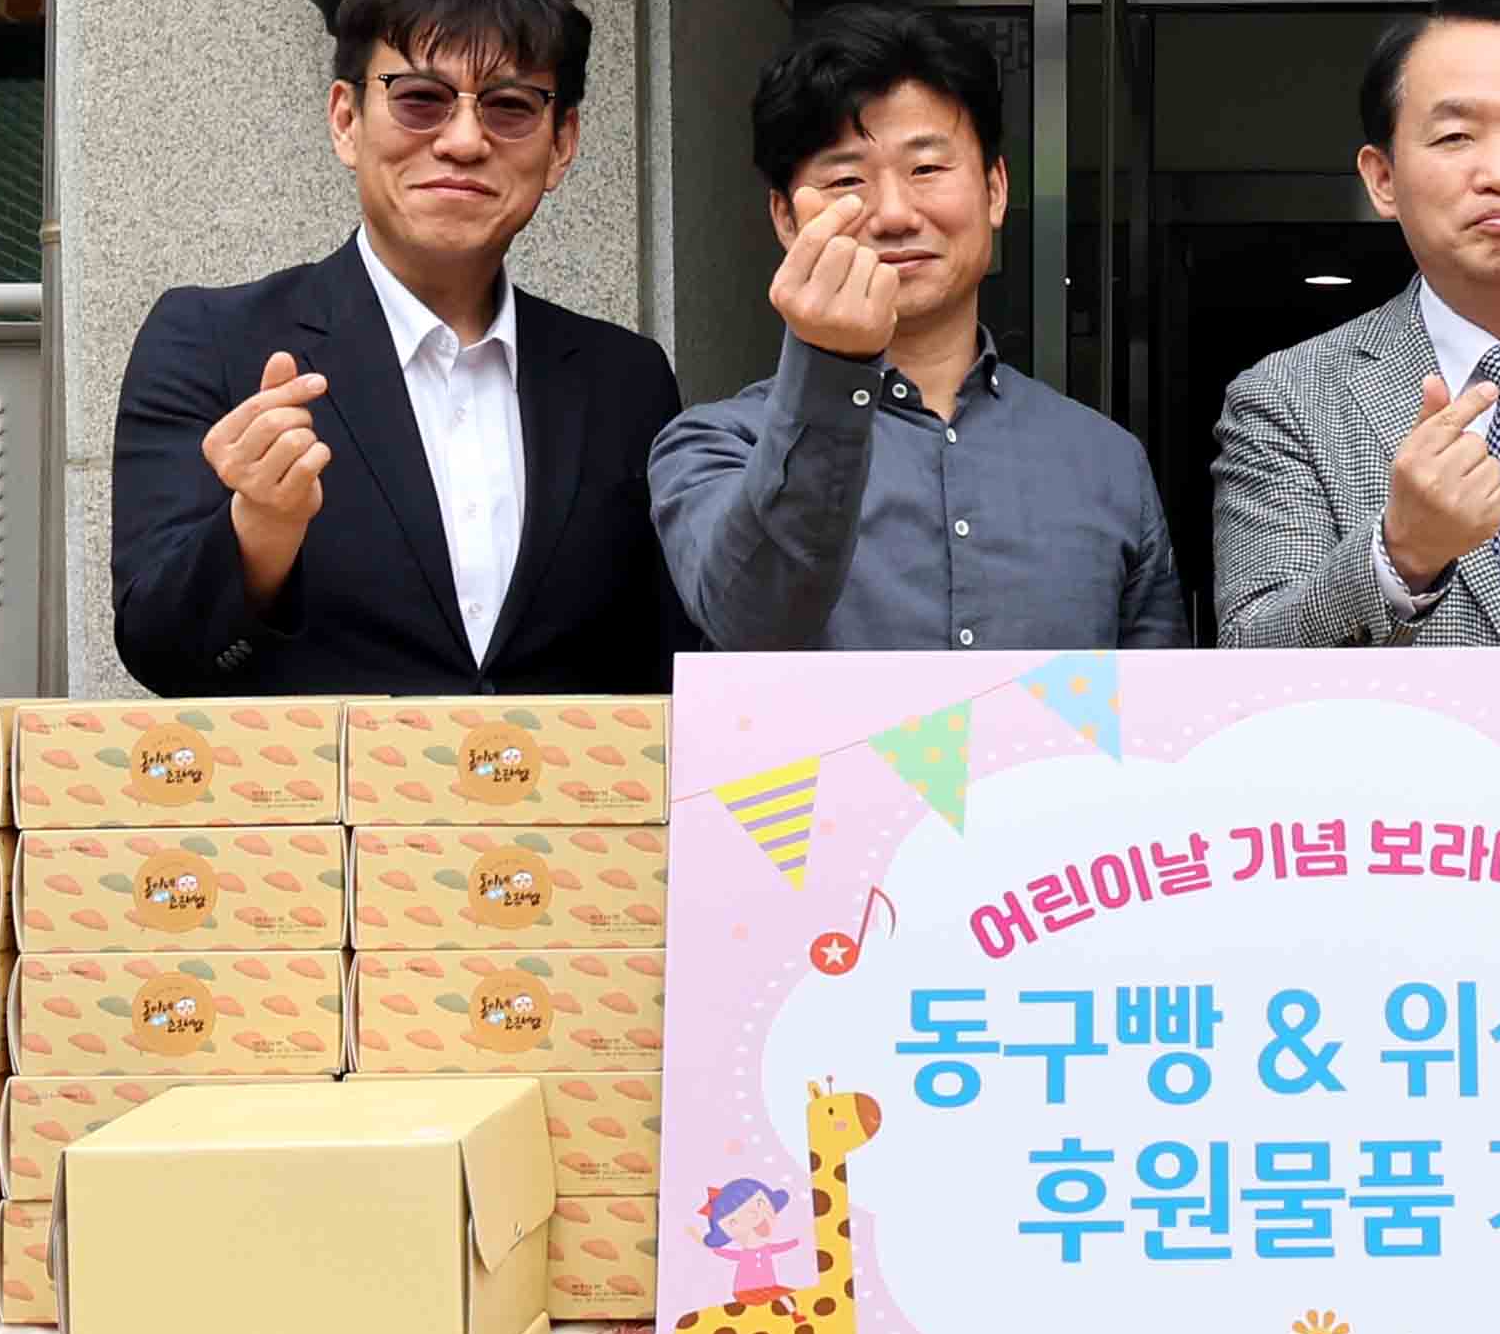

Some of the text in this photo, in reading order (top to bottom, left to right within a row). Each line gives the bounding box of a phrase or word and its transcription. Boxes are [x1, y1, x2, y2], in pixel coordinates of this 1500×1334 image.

[970, 833, 1212, 959] 어린이날
[1230, 819, 1347, 880] 기념
[896, 986, 1223, 1107] 동구빵
[1258, 990, 1345, 1094] &
[1019, 1138, 1454, 1263] 후원물품
